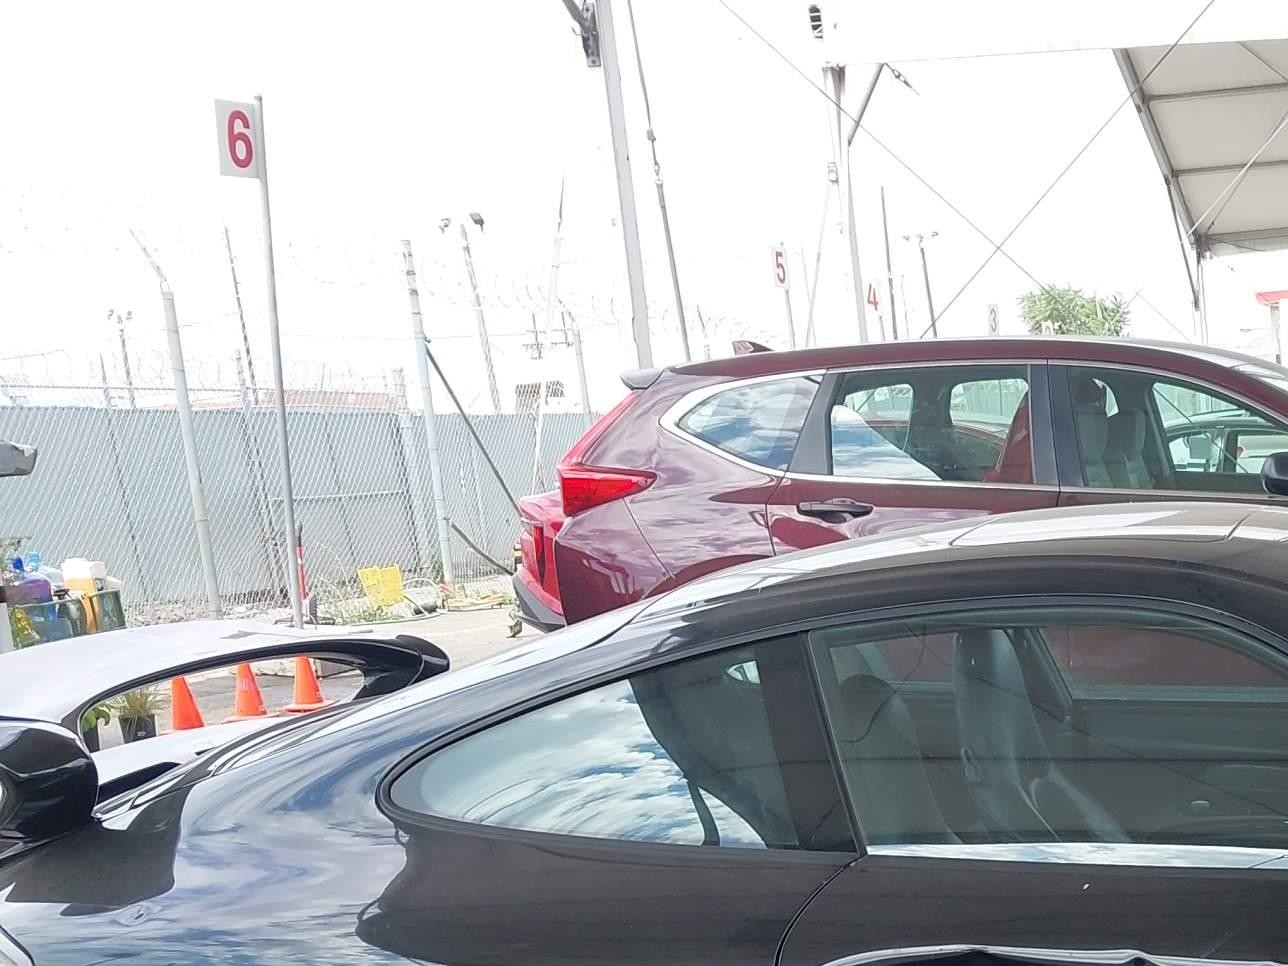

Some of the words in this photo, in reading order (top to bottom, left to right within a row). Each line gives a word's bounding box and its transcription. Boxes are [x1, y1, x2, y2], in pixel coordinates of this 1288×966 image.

[228, 110, 253, 168] 6
[775, 251, 786, 284] 5
[867, 283, 879, 311] 4
